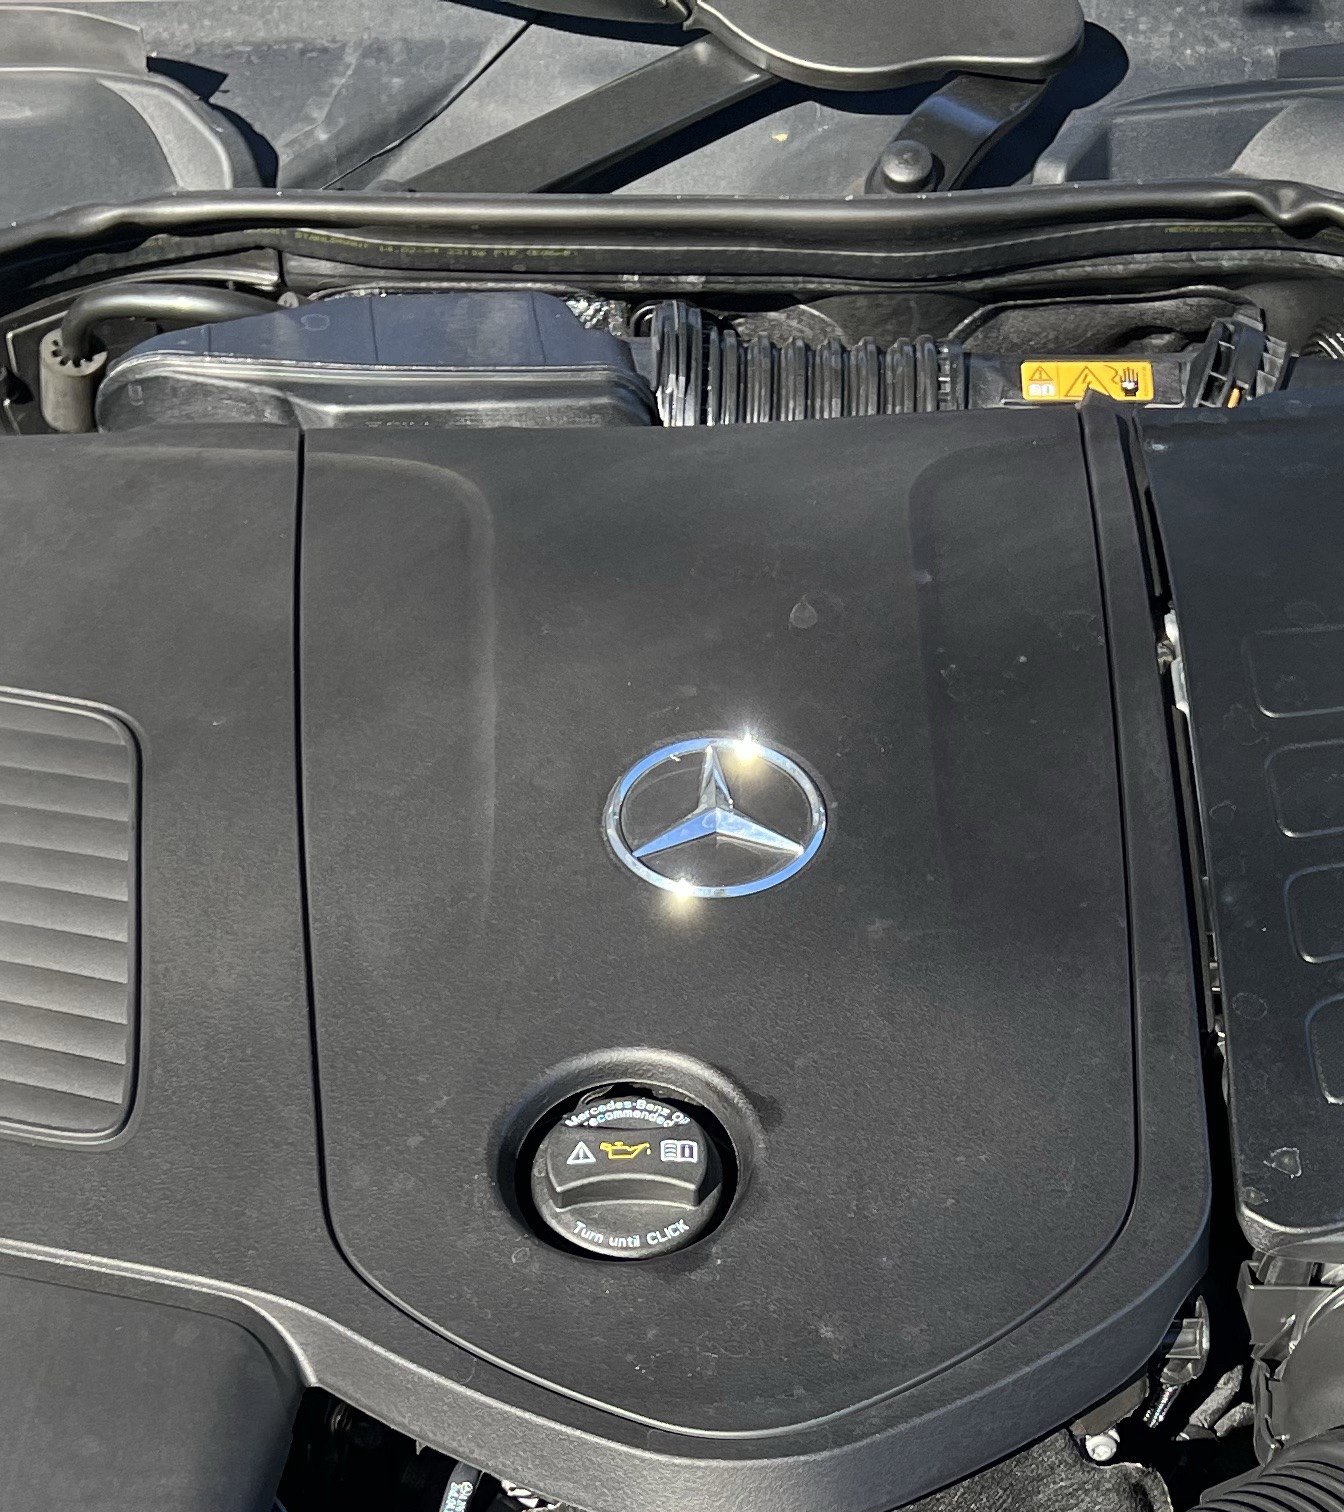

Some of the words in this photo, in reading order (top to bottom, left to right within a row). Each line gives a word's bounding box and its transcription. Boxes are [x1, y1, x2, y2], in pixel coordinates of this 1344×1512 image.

[564, 1098, 670, 1126] Mercedes-Benz
[573, 1220, 604, 1243] Turn
[608, 1234, 641, 1248] until
[646, 1219, 690, 1245] CLICK
